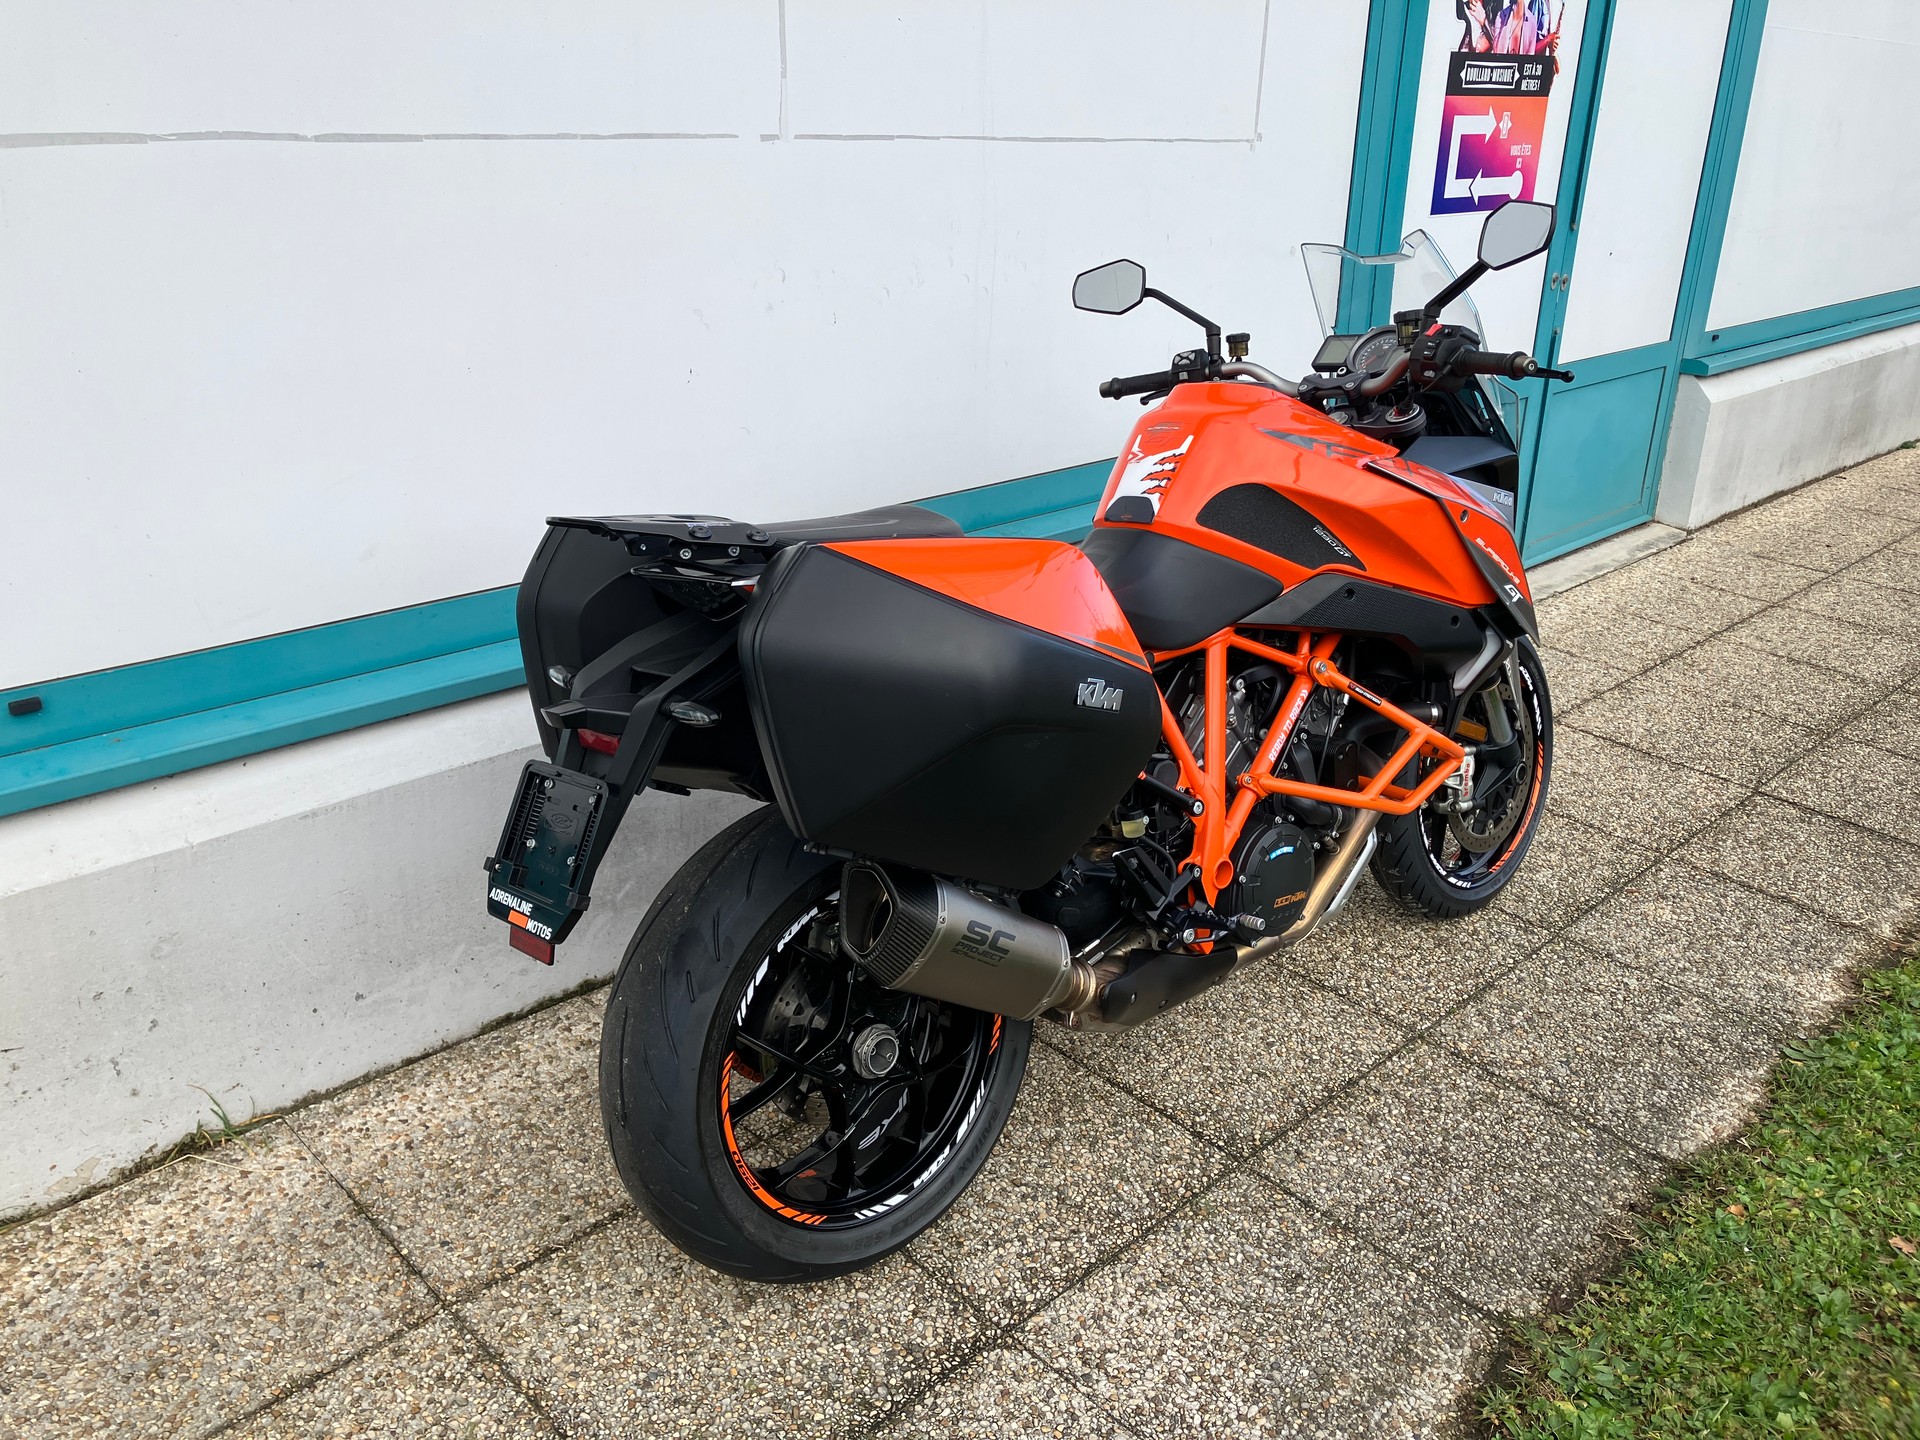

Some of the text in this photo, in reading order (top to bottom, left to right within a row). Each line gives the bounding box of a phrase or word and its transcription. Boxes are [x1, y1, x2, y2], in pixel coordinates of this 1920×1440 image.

[1523, 64, 1532, 75] EST
[1511, 143, 1532, 155] VOUS ÊTES
[1493, 490, 1512, 506] KTM
[1504, 584, 1523, 602] GT
[1077, 678, 1124, 711] KTM
[1268, 698, 1304, 763] READY TO RACE
[1463, 763, 1471, 797] brembo
[489, 887, 533, 916] ADRENALINE
[526, 918, 552, 940] MOTOS
[961, 919, 1017, 956] SC
[955, 941, 1008, 963] PROJECT
[731, 1150, 761, 1192] 1290
[913, 1144, 951, 1189] KTM
